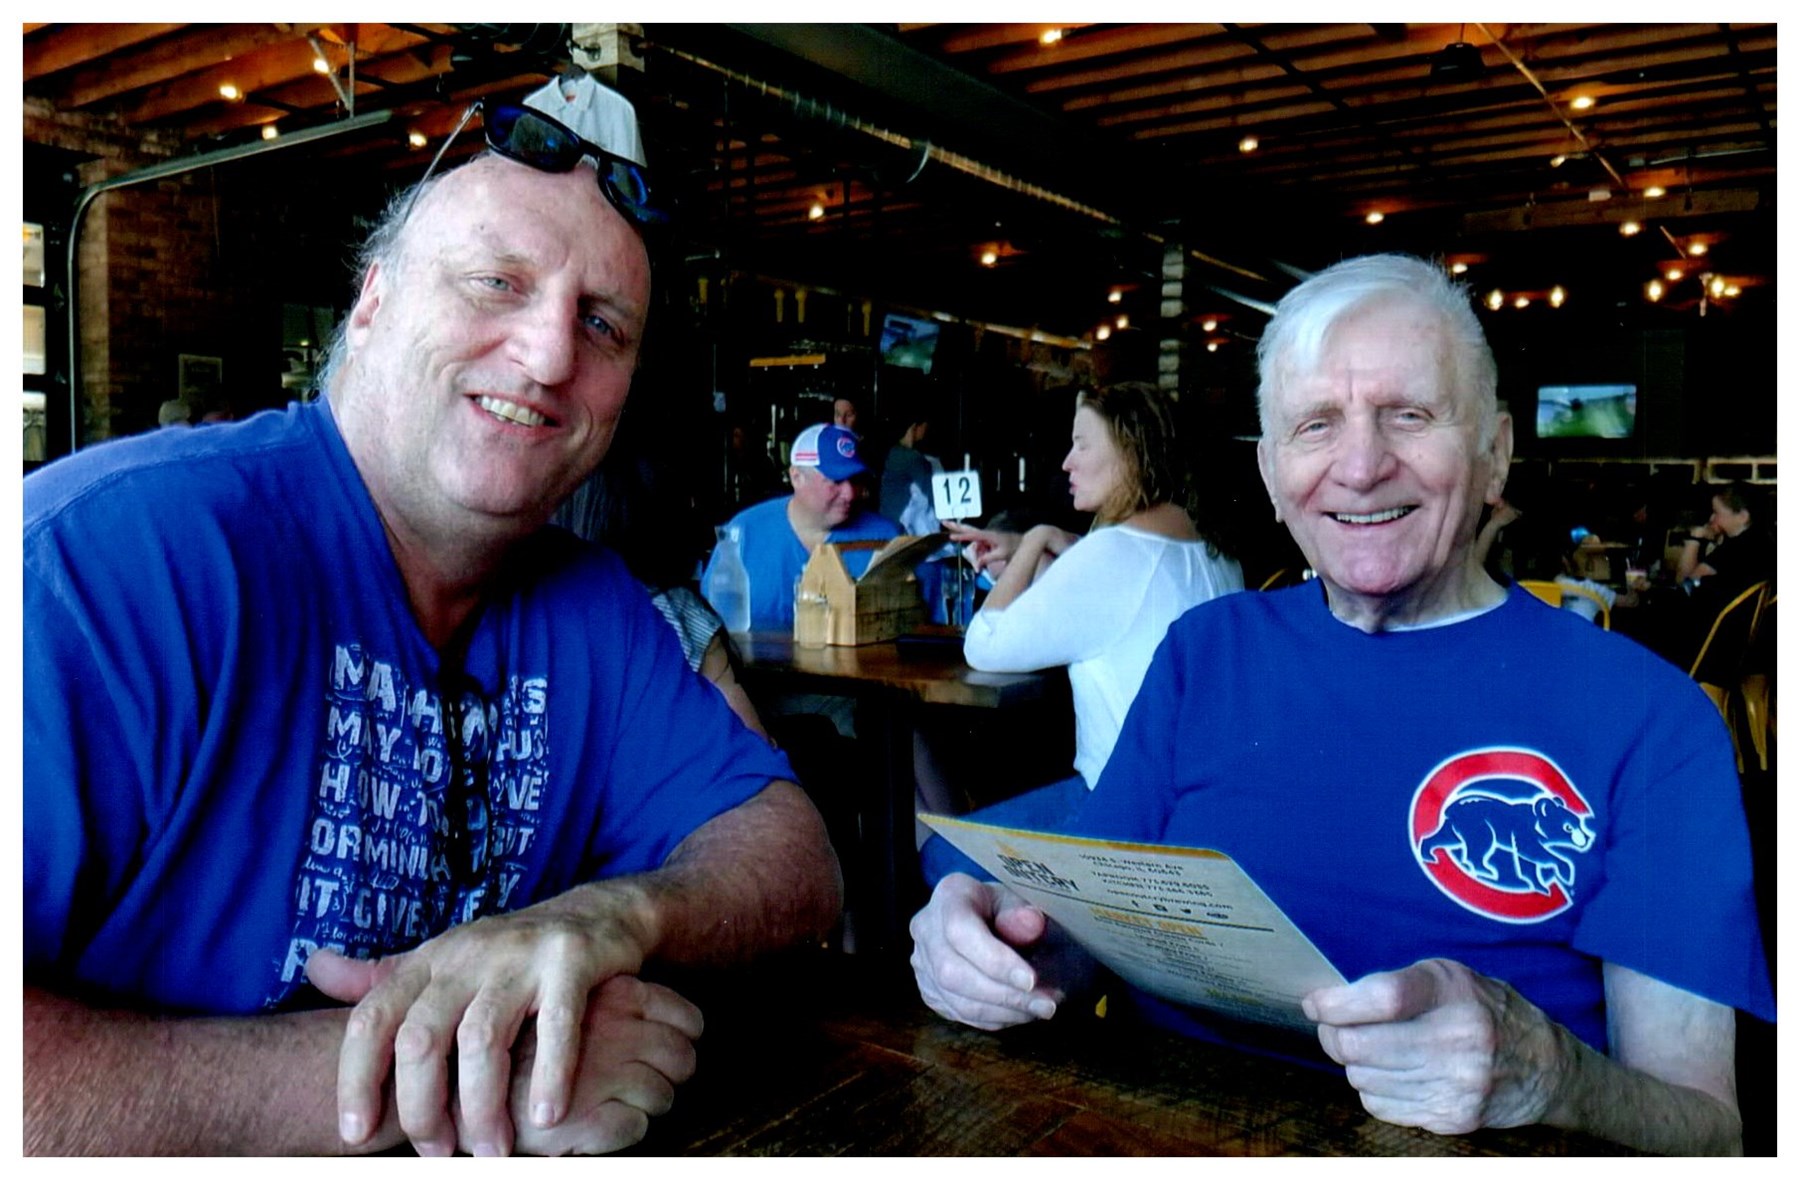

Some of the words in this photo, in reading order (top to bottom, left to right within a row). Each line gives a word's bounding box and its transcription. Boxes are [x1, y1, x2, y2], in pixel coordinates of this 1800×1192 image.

[943, 476, 972, 505] 12
[319, 762, 402, 821] HOW
[310, 818, 362, 860] OR
[298, 876, 340, 919] IT
